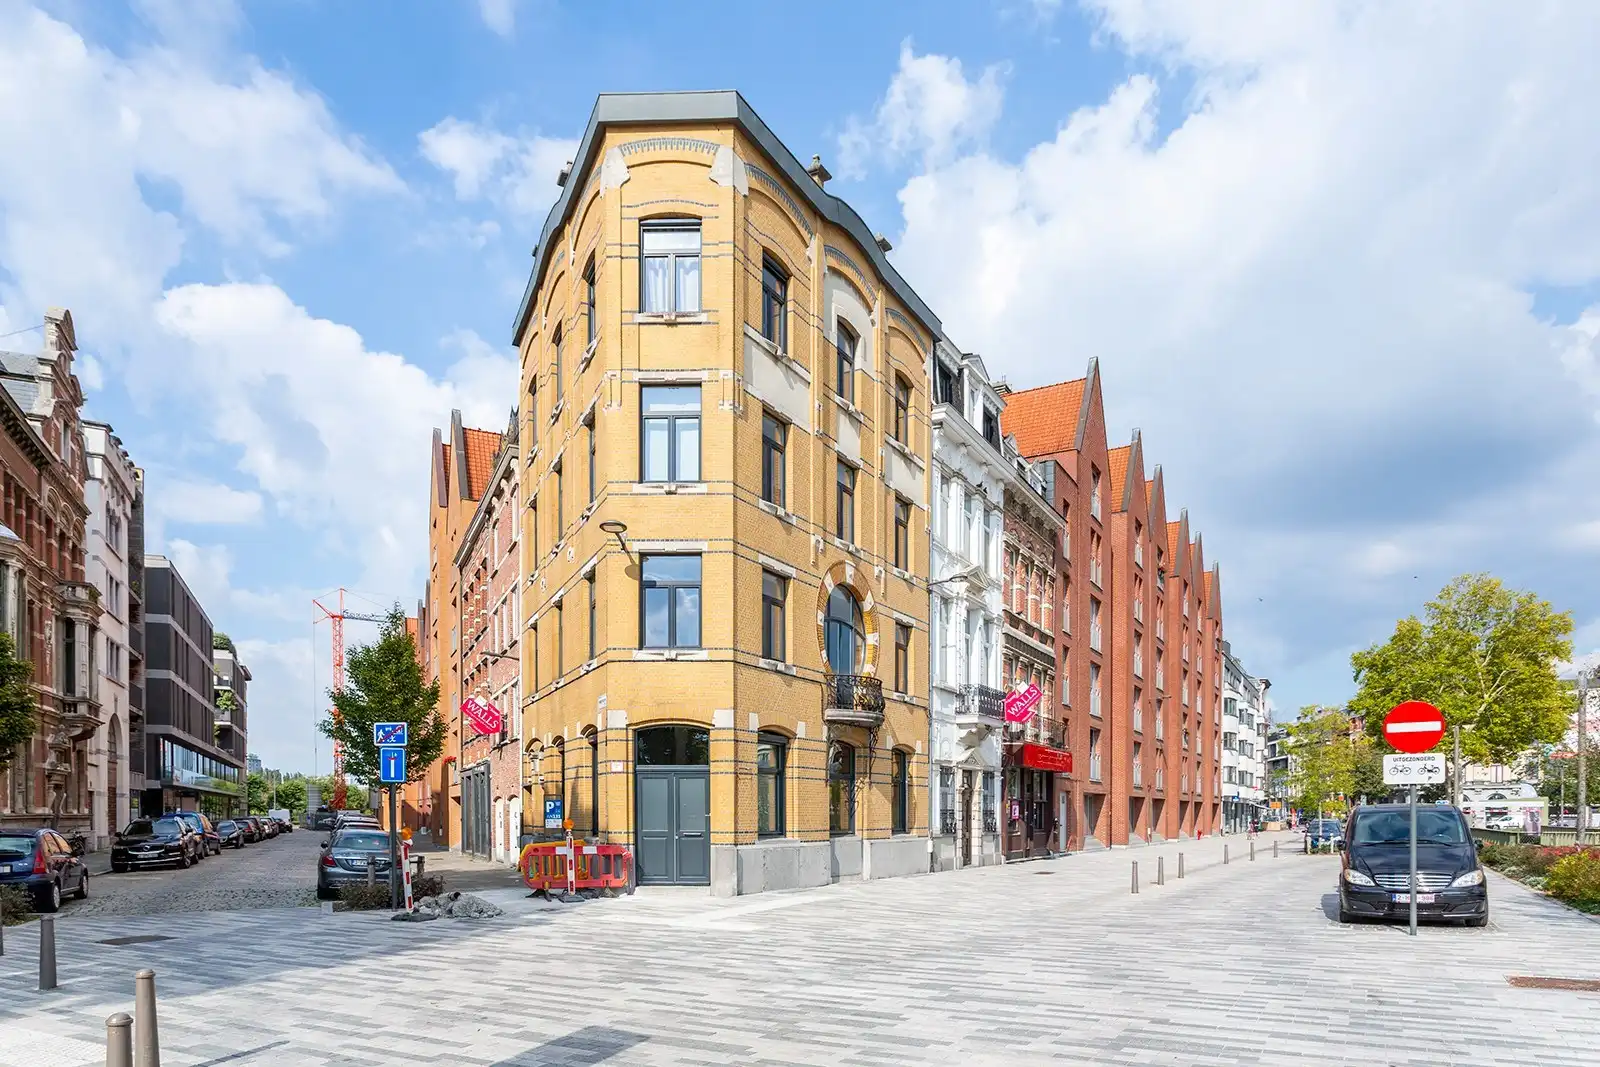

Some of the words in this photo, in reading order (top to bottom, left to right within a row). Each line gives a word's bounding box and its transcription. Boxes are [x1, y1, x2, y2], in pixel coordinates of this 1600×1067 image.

[467, 700, 499, 729] WALLS
[1008, 687, 1037, 715] WALLS
[546, 801, 555, 813] P
